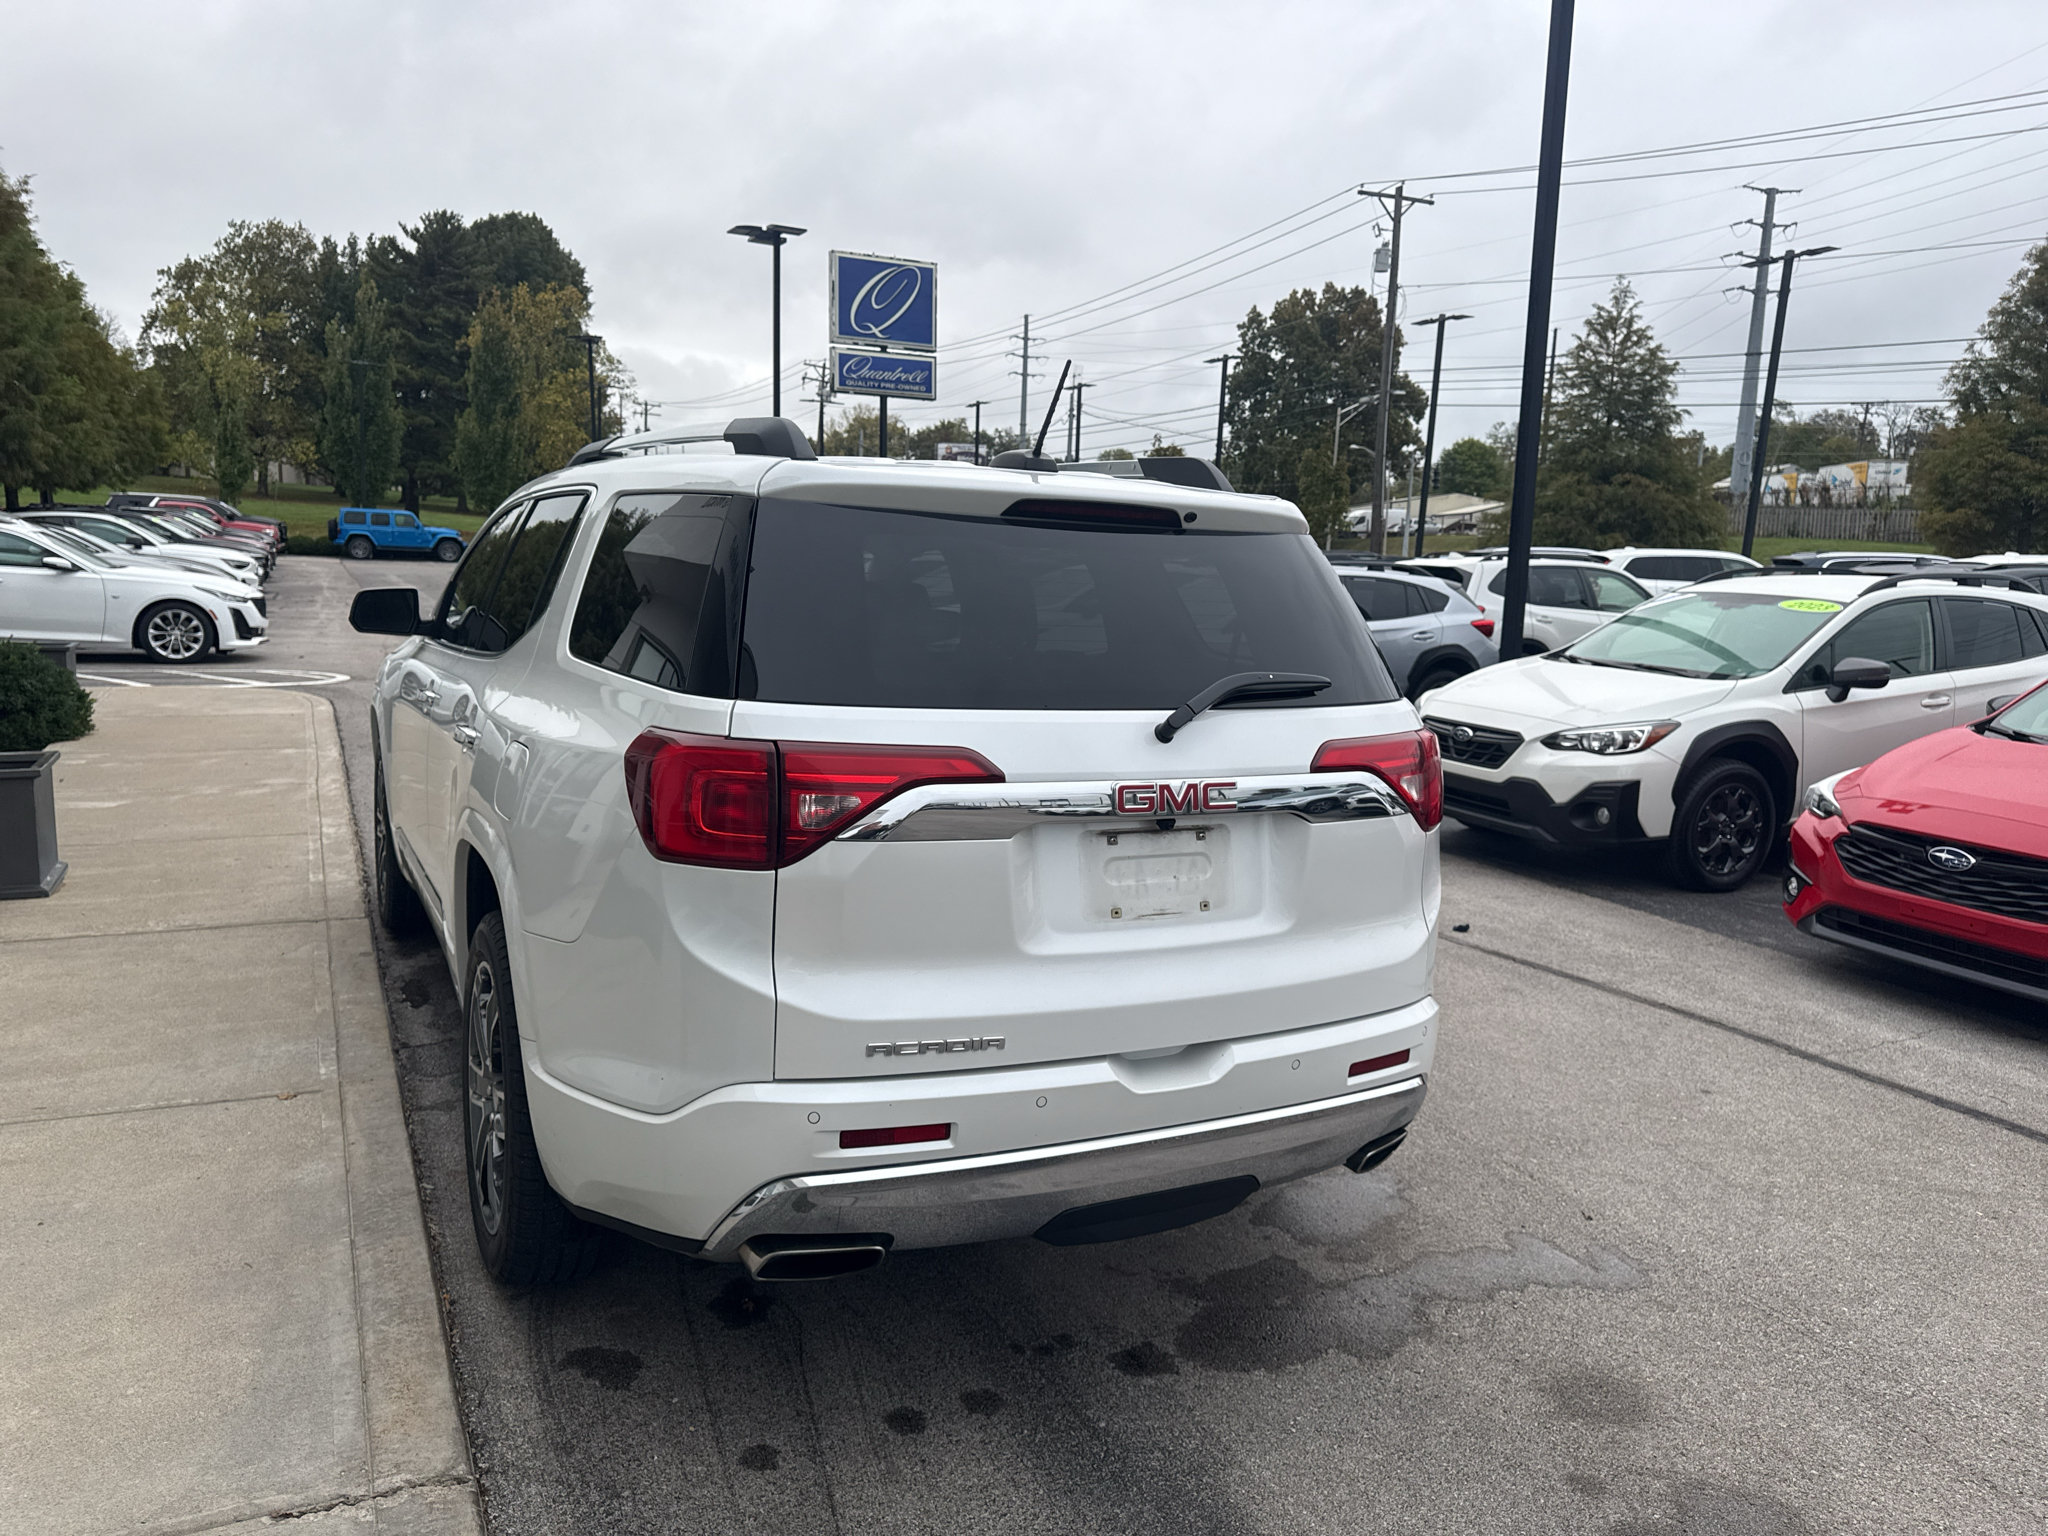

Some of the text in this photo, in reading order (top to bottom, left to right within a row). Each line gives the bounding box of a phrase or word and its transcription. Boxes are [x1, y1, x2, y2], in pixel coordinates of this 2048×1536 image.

[851, 266, 921, 338] Q
[843, 356, 929, 383] Quantrell
[846, 379, 927, 392] QUALITY PRE-OWNED
[1112, 781, 1238, 815] GMC
[866, 1036, 1006, 1057] ACADIA
